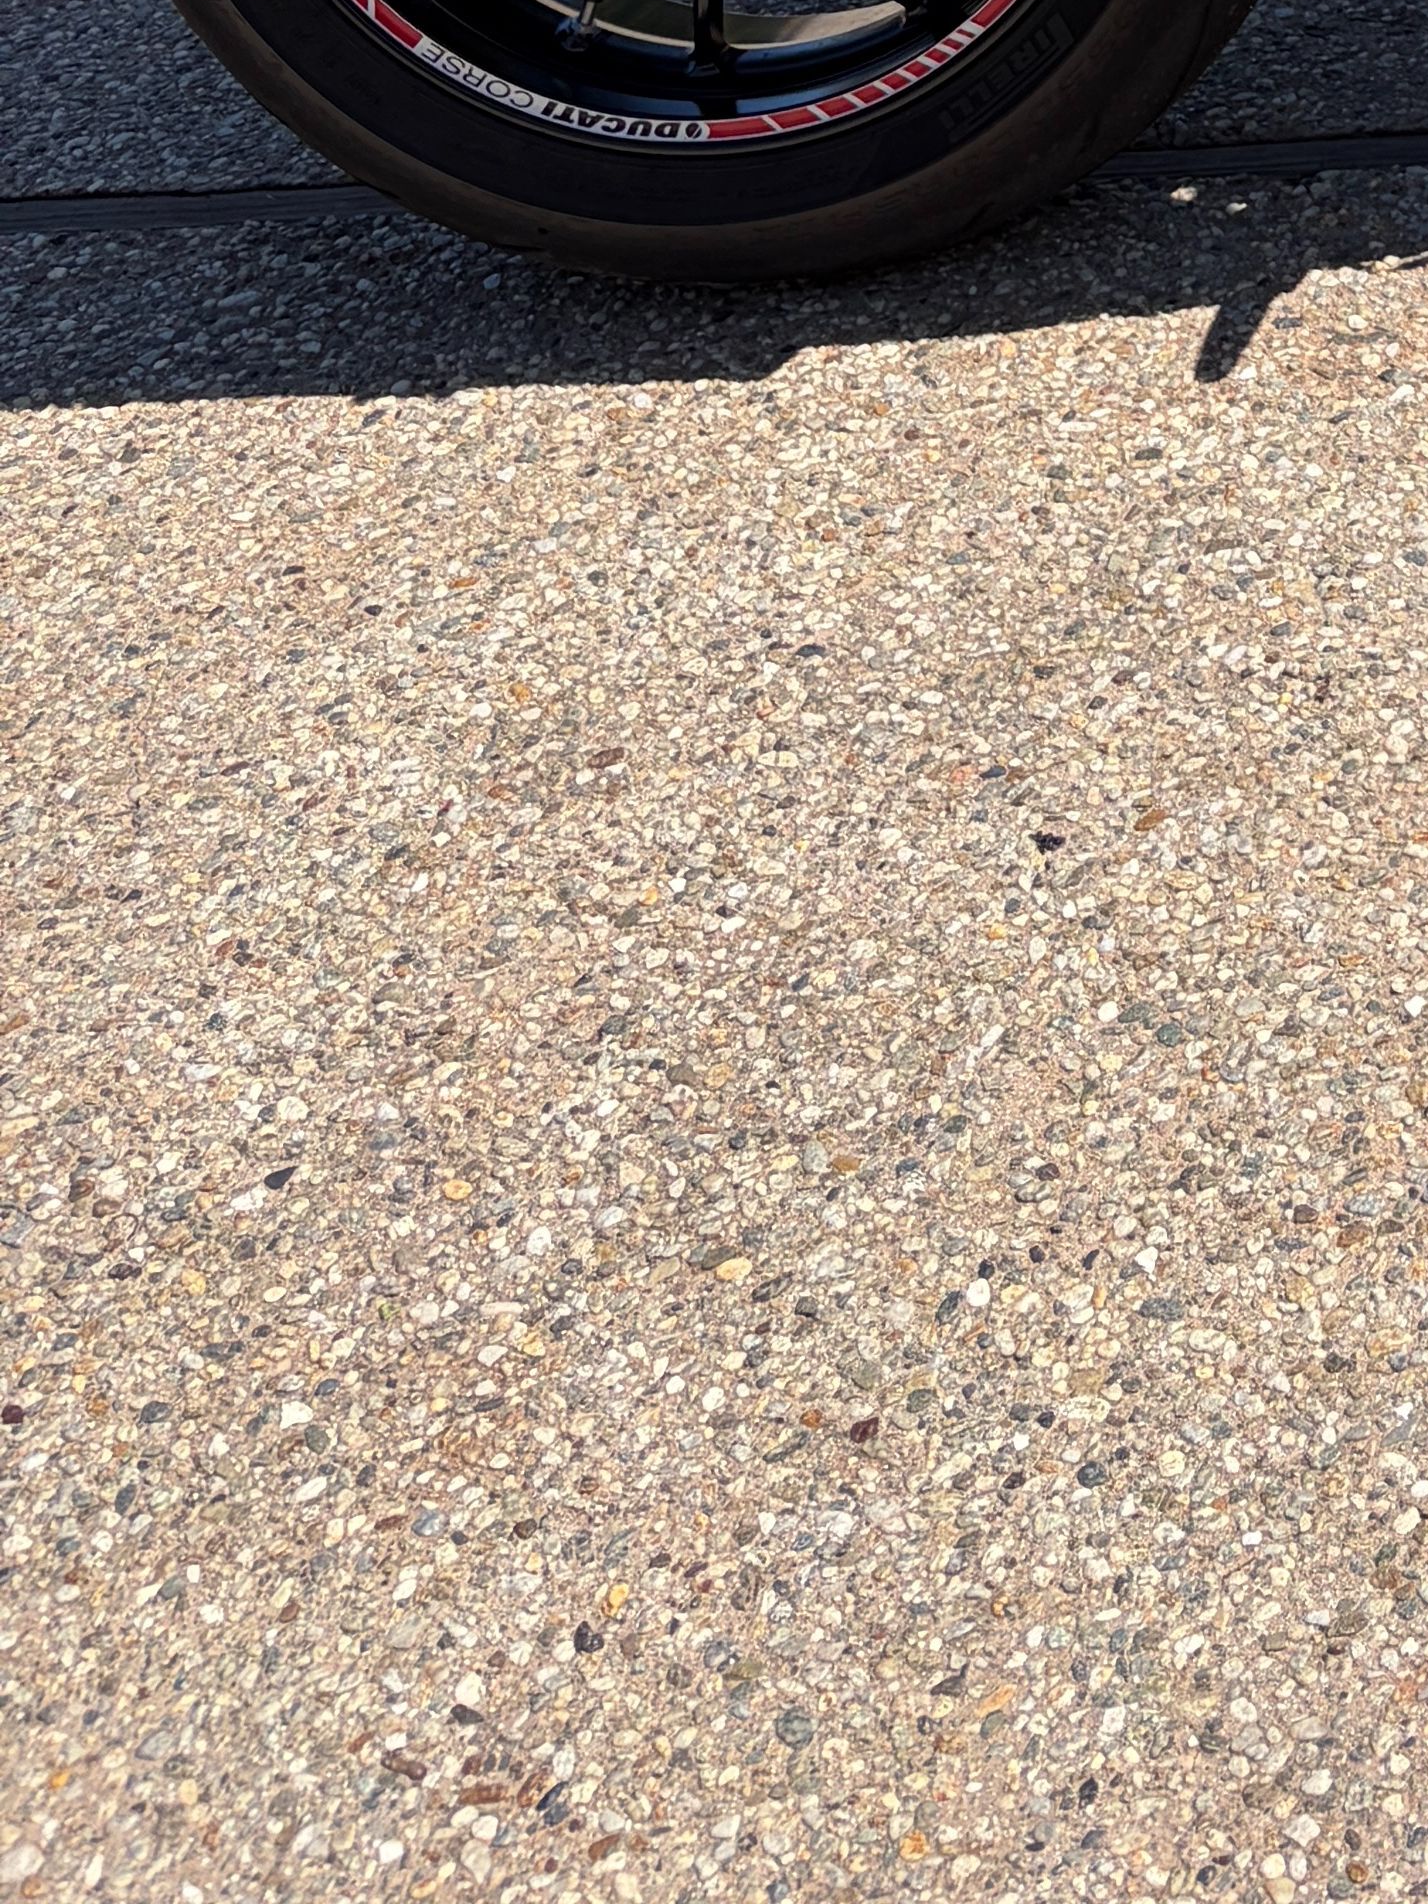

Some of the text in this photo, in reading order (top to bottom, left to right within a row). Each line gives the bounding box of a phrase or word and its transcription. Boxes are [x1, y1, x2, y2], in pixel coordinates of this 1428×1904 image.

[421, 39, 534, 111] CORSE
[932, 11, 1080, 145] PIRELLI
[540, 98, 680, 138] DUCATI
